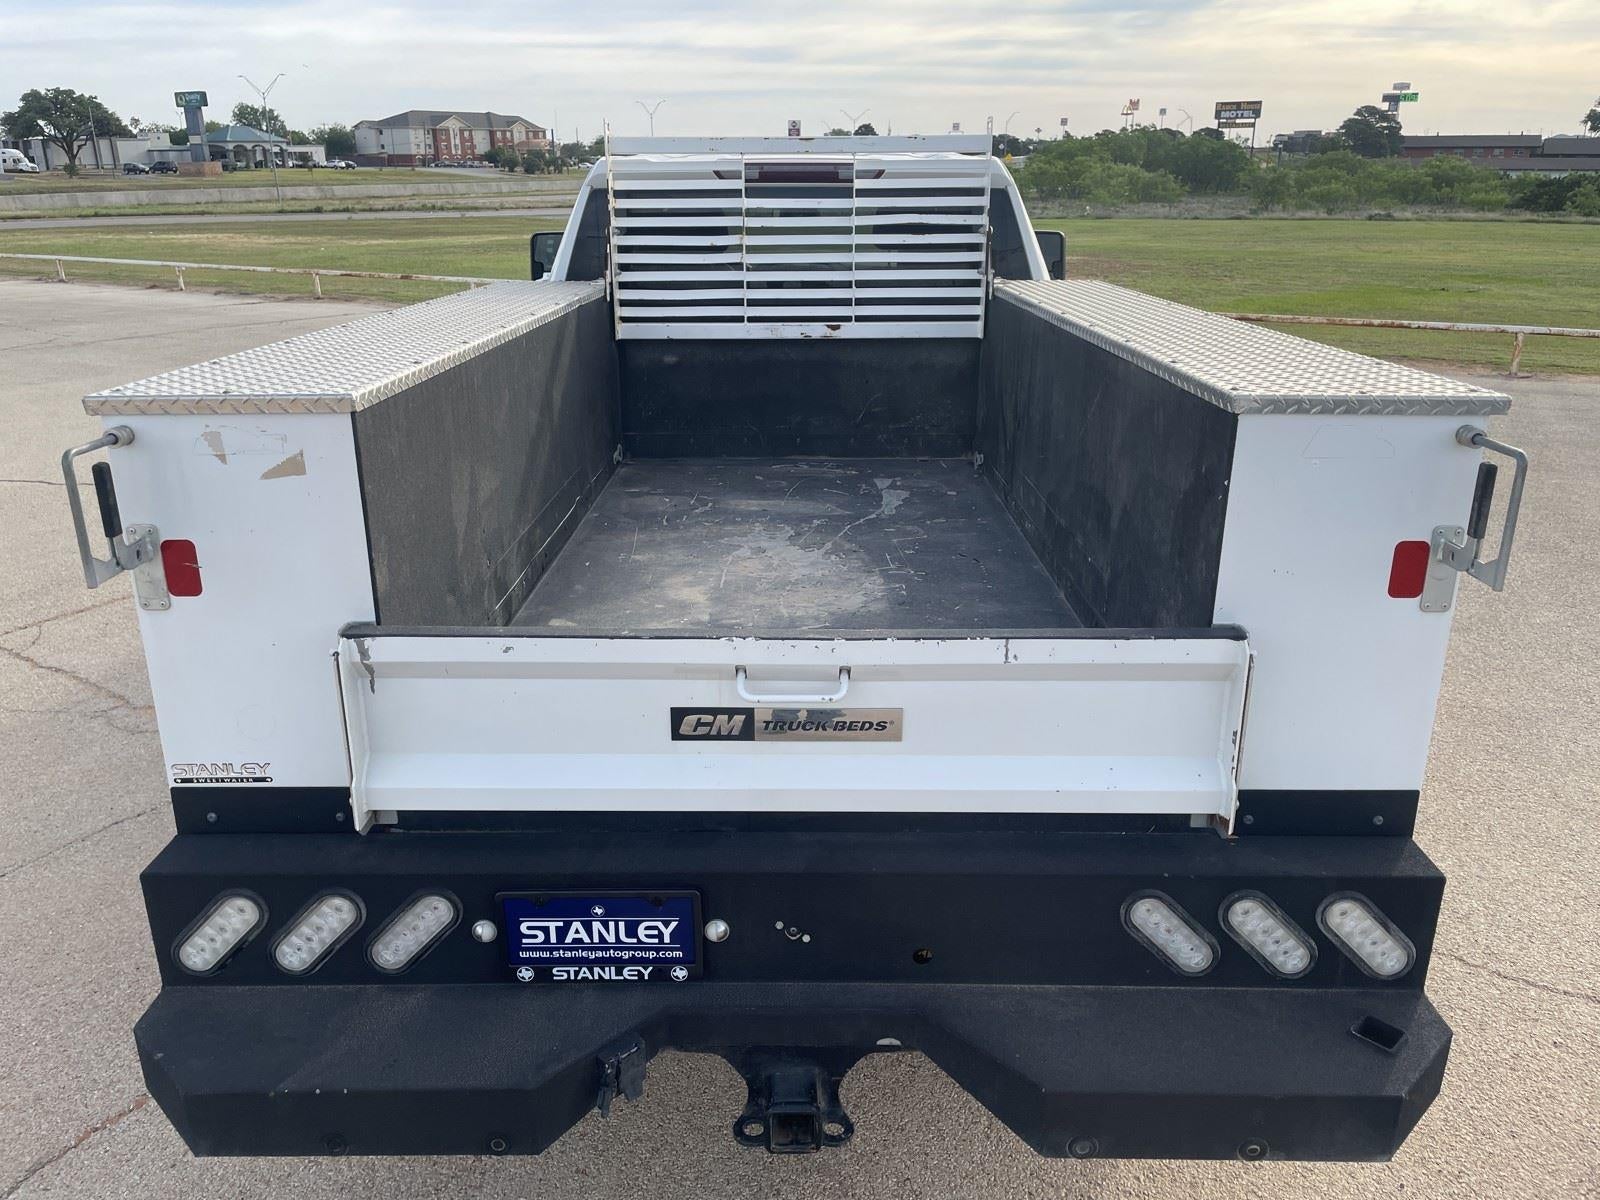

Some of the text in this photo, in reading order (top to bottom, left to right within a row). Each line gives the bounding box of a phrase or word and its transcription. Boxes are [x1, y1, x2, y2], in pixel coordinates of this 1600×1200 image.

[1220, 110, 1256, 118] MOTEL
[679, 714, 746, 735] CM
[762, 720, 828, 731] TRUCK
[171, 762, 271, 776] STANLEY
[519, 921, 679, 943] STANLEY
[519, 949, 683, 959] www.stanleyautogroup.com
[552, 966, 653, 980] STANLEY
